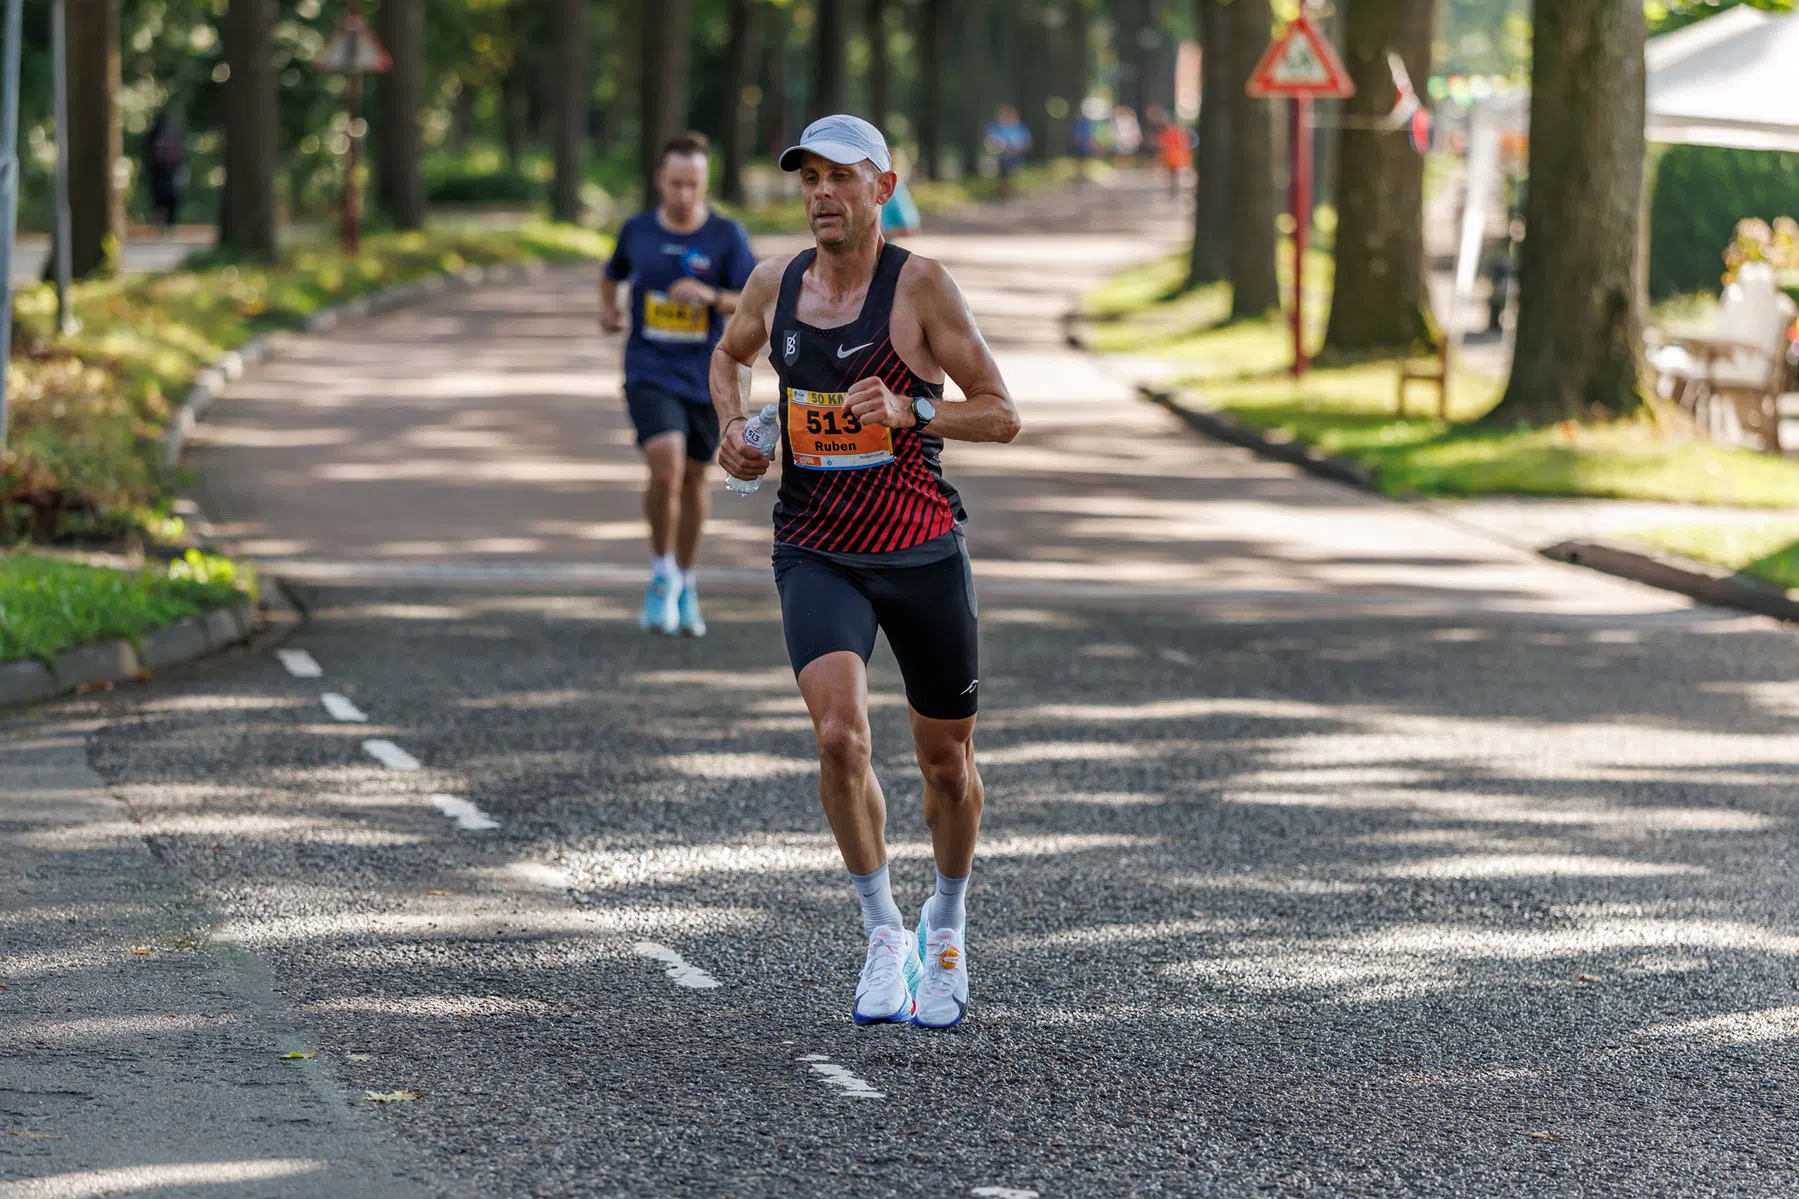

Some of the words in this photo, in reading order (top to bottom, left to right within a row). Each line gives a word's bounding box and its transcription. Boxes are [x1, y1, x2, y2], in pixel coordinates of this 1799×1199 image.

[812, 393, 825, 404] 50
[807, 410, 862, 435] 513
[748, 429, 760, 442] 513
[815, 441, 856, 451] Ruben
